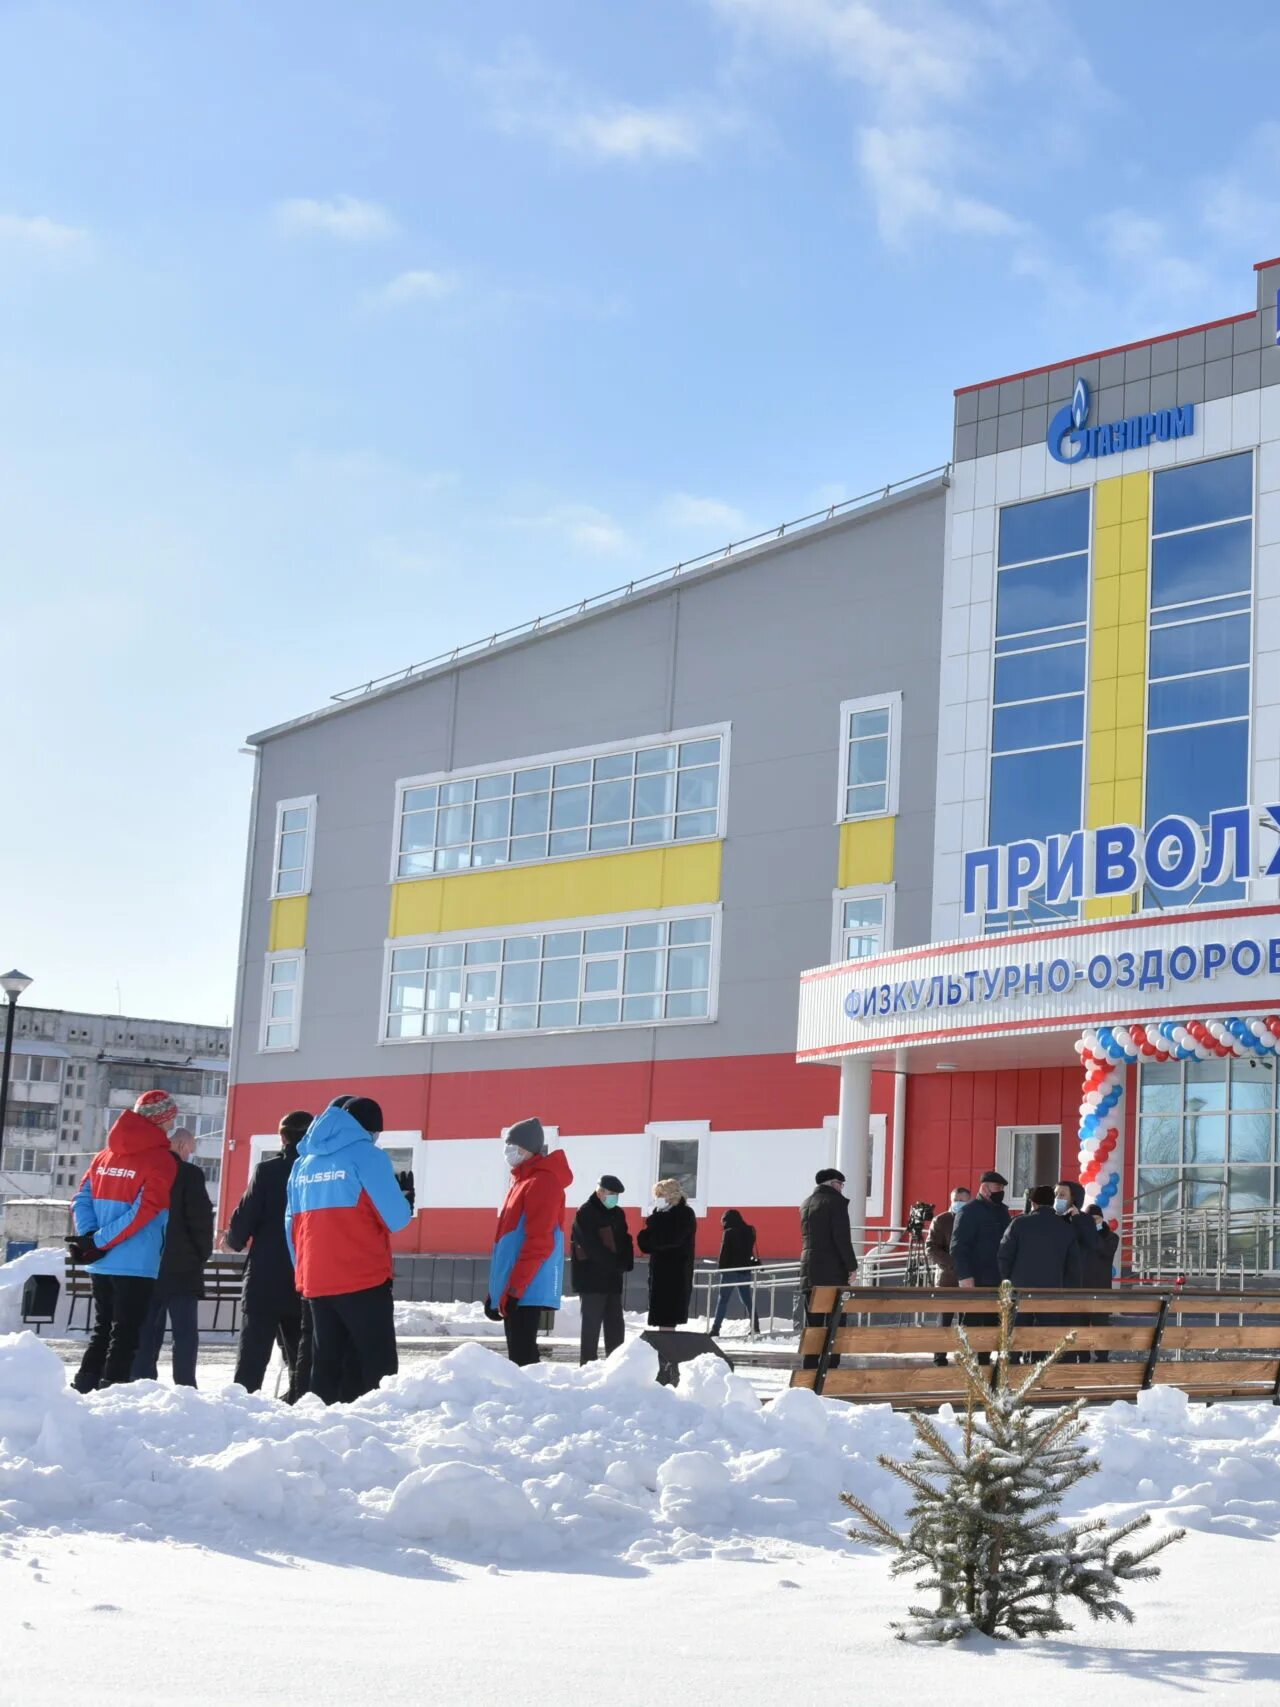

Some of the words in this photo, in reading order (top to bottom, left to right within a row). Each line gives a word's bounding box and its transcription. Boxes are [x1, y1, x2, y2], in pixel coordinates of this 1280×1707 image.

[1086, 403, 1194, 459] ГАЗПРОМ
[96, 1166, 136, 1179] RUSSIA
[298, 1170, 345, 1187] RUSSIA
